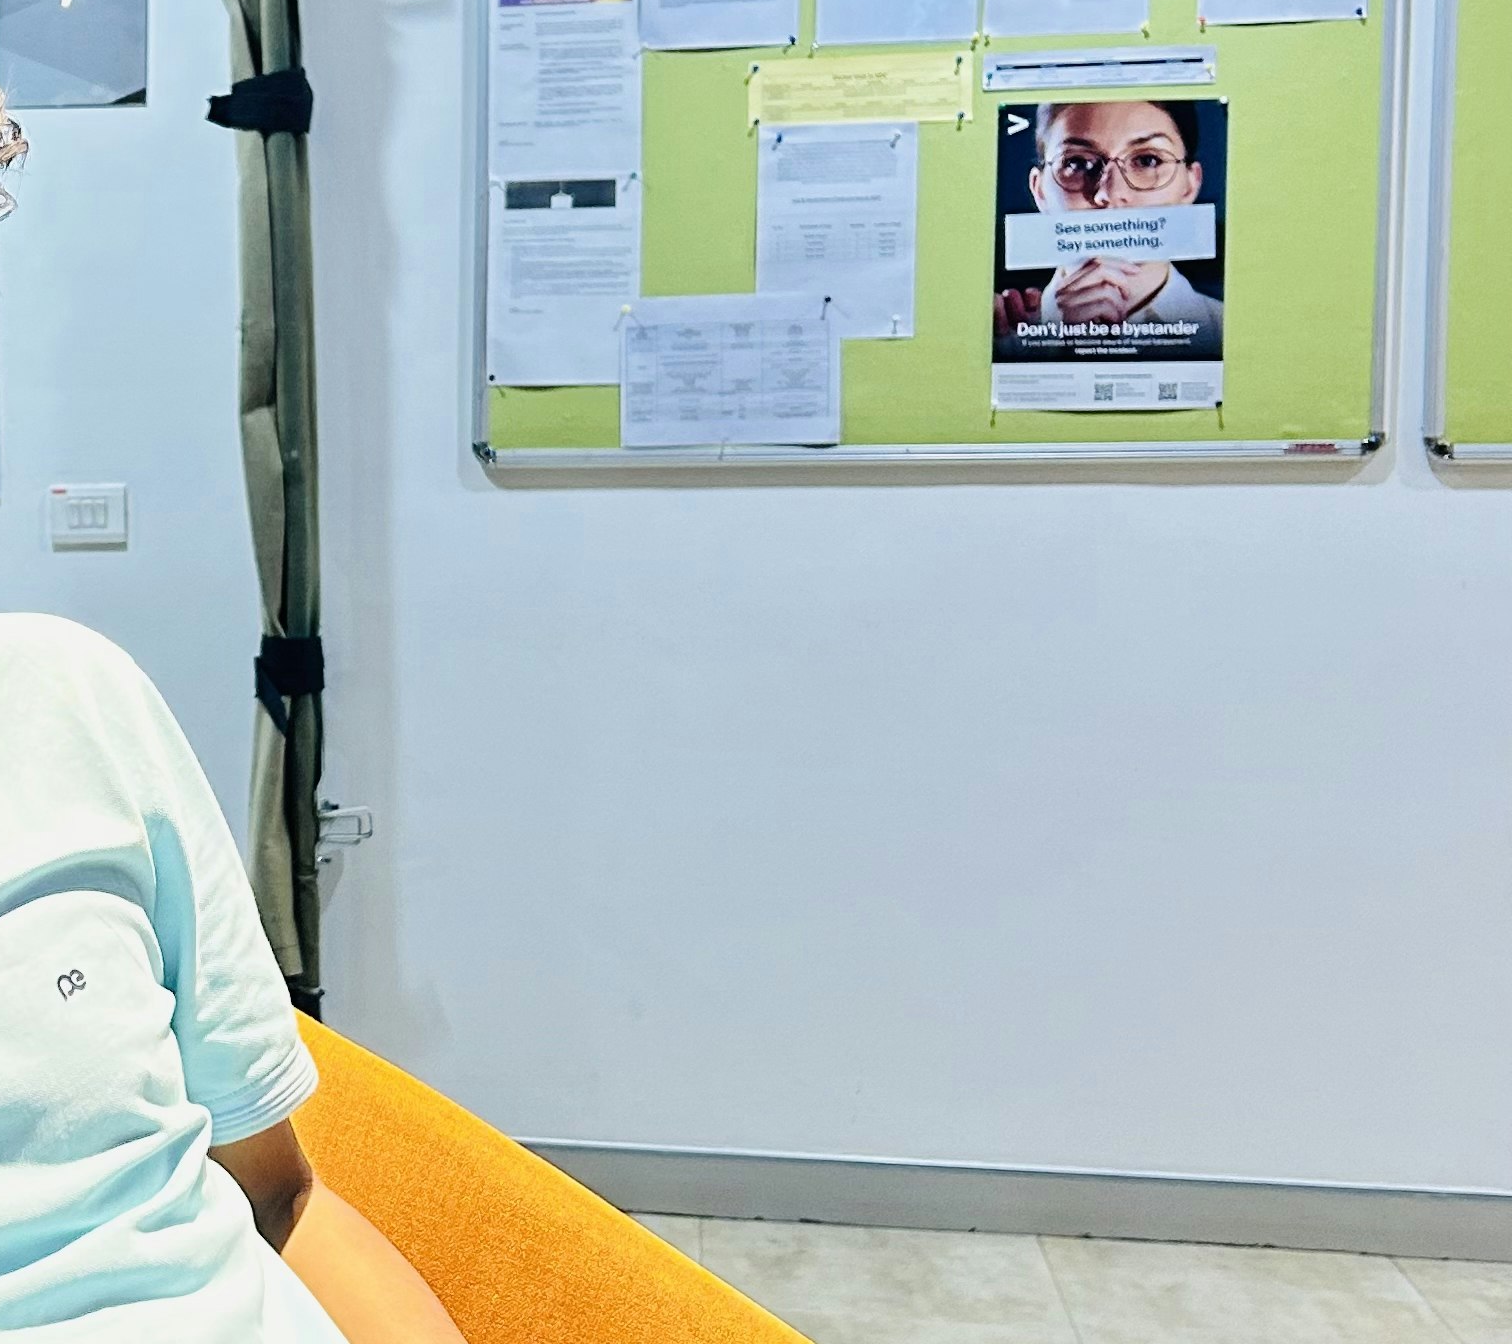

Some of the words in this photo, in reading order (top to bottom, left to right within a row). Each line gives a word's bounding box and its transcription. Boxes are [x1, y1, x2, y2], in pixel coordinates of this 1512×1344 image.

[1055, 222, 1082, 235] See
[1084, 217, 1167, 234] something?
[1057, 238, 1082, 253] Say
[1085, 234, 1165, 250] something.
[1016, 321, 1056, 337] Don't
[1058, 321, 1087, 338] just
[1089, 320, 1110, 336] be
[1110, 325, 1121, 336] a
[1122, 320, 1200, 338] bystander
